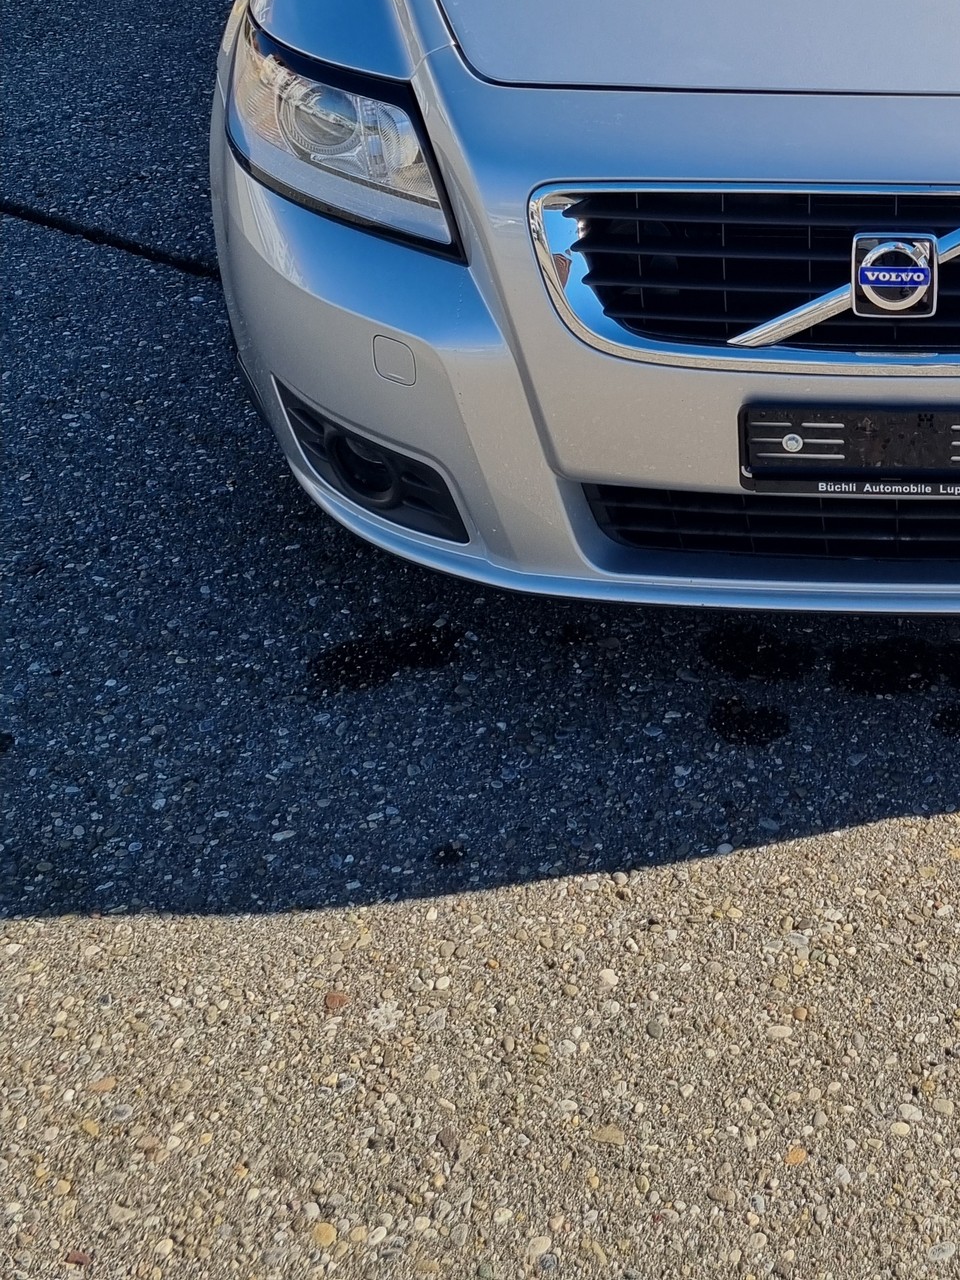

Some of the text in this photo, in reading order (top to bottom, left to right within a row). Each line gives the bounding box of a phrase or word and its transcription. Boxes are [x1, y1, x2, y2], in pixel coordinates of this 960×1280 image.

[864, 271, 925, 282] VOLVO
[818, 482, 857, 493] Büchli
[863, 483, 932, 494] Automobile
